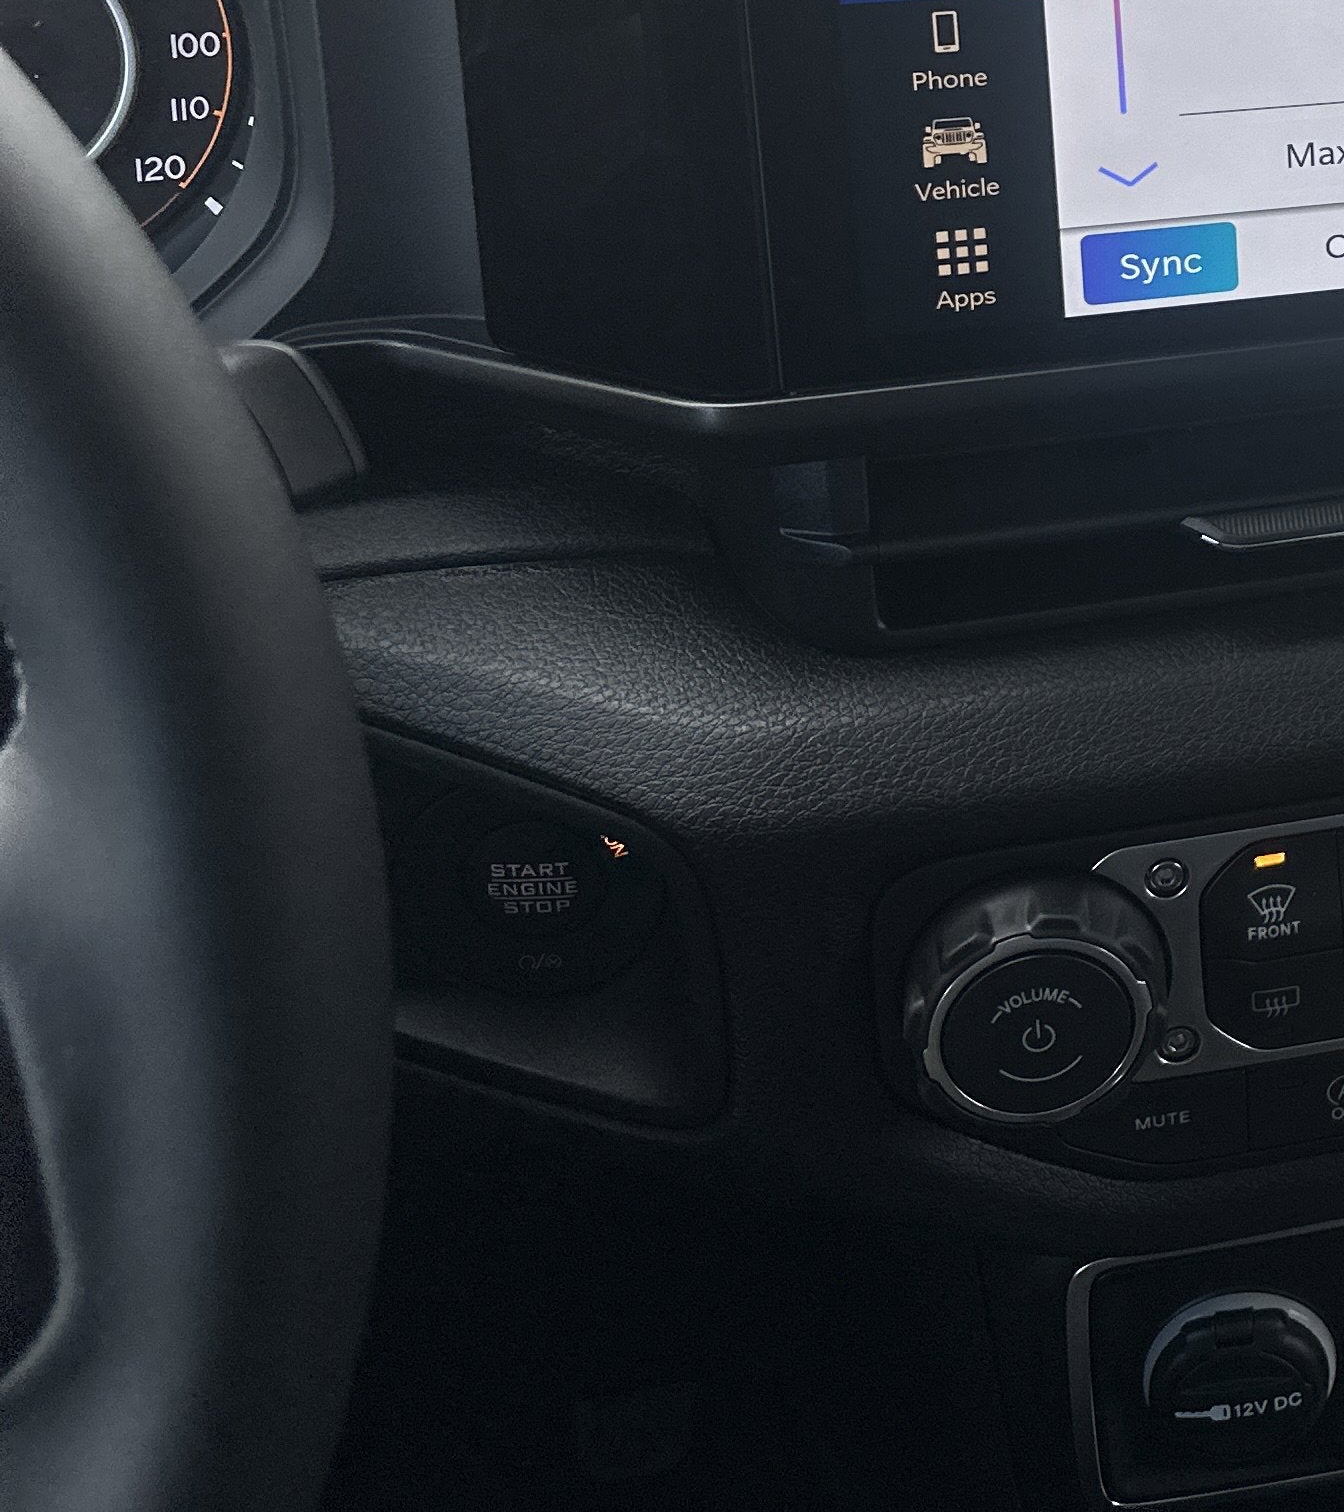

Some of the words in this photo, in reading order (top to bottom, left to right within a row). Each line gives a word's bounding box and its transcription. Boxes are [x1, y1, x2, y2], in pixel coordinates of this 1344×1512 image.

[171, 32, 220, 58] 100
[912, 67, 988, 91] Phone
[171, 96, 209, 120] 110
[135, 155, 186, 183] 120
[915, 177, 1000, 203] Vehicle
[1120, 253, 1203, 283] Sync
[936, 287, 997, 311] Apps
[600, 835, 629, 857] UN
[490, 862, 569, 877] START
[488, 880, 578, 896] ENGINE
[503, 899, 571, 913] STOP
[1247, 919, 1300, 939] FRONT
[999, 988, 1070, 1016] VOLUME
[1135, 1110, 1191, 1131] MUTE
[1233, 1399, 1264, 1419] 12V
[1269, 1391, 1304, 1413] DC
